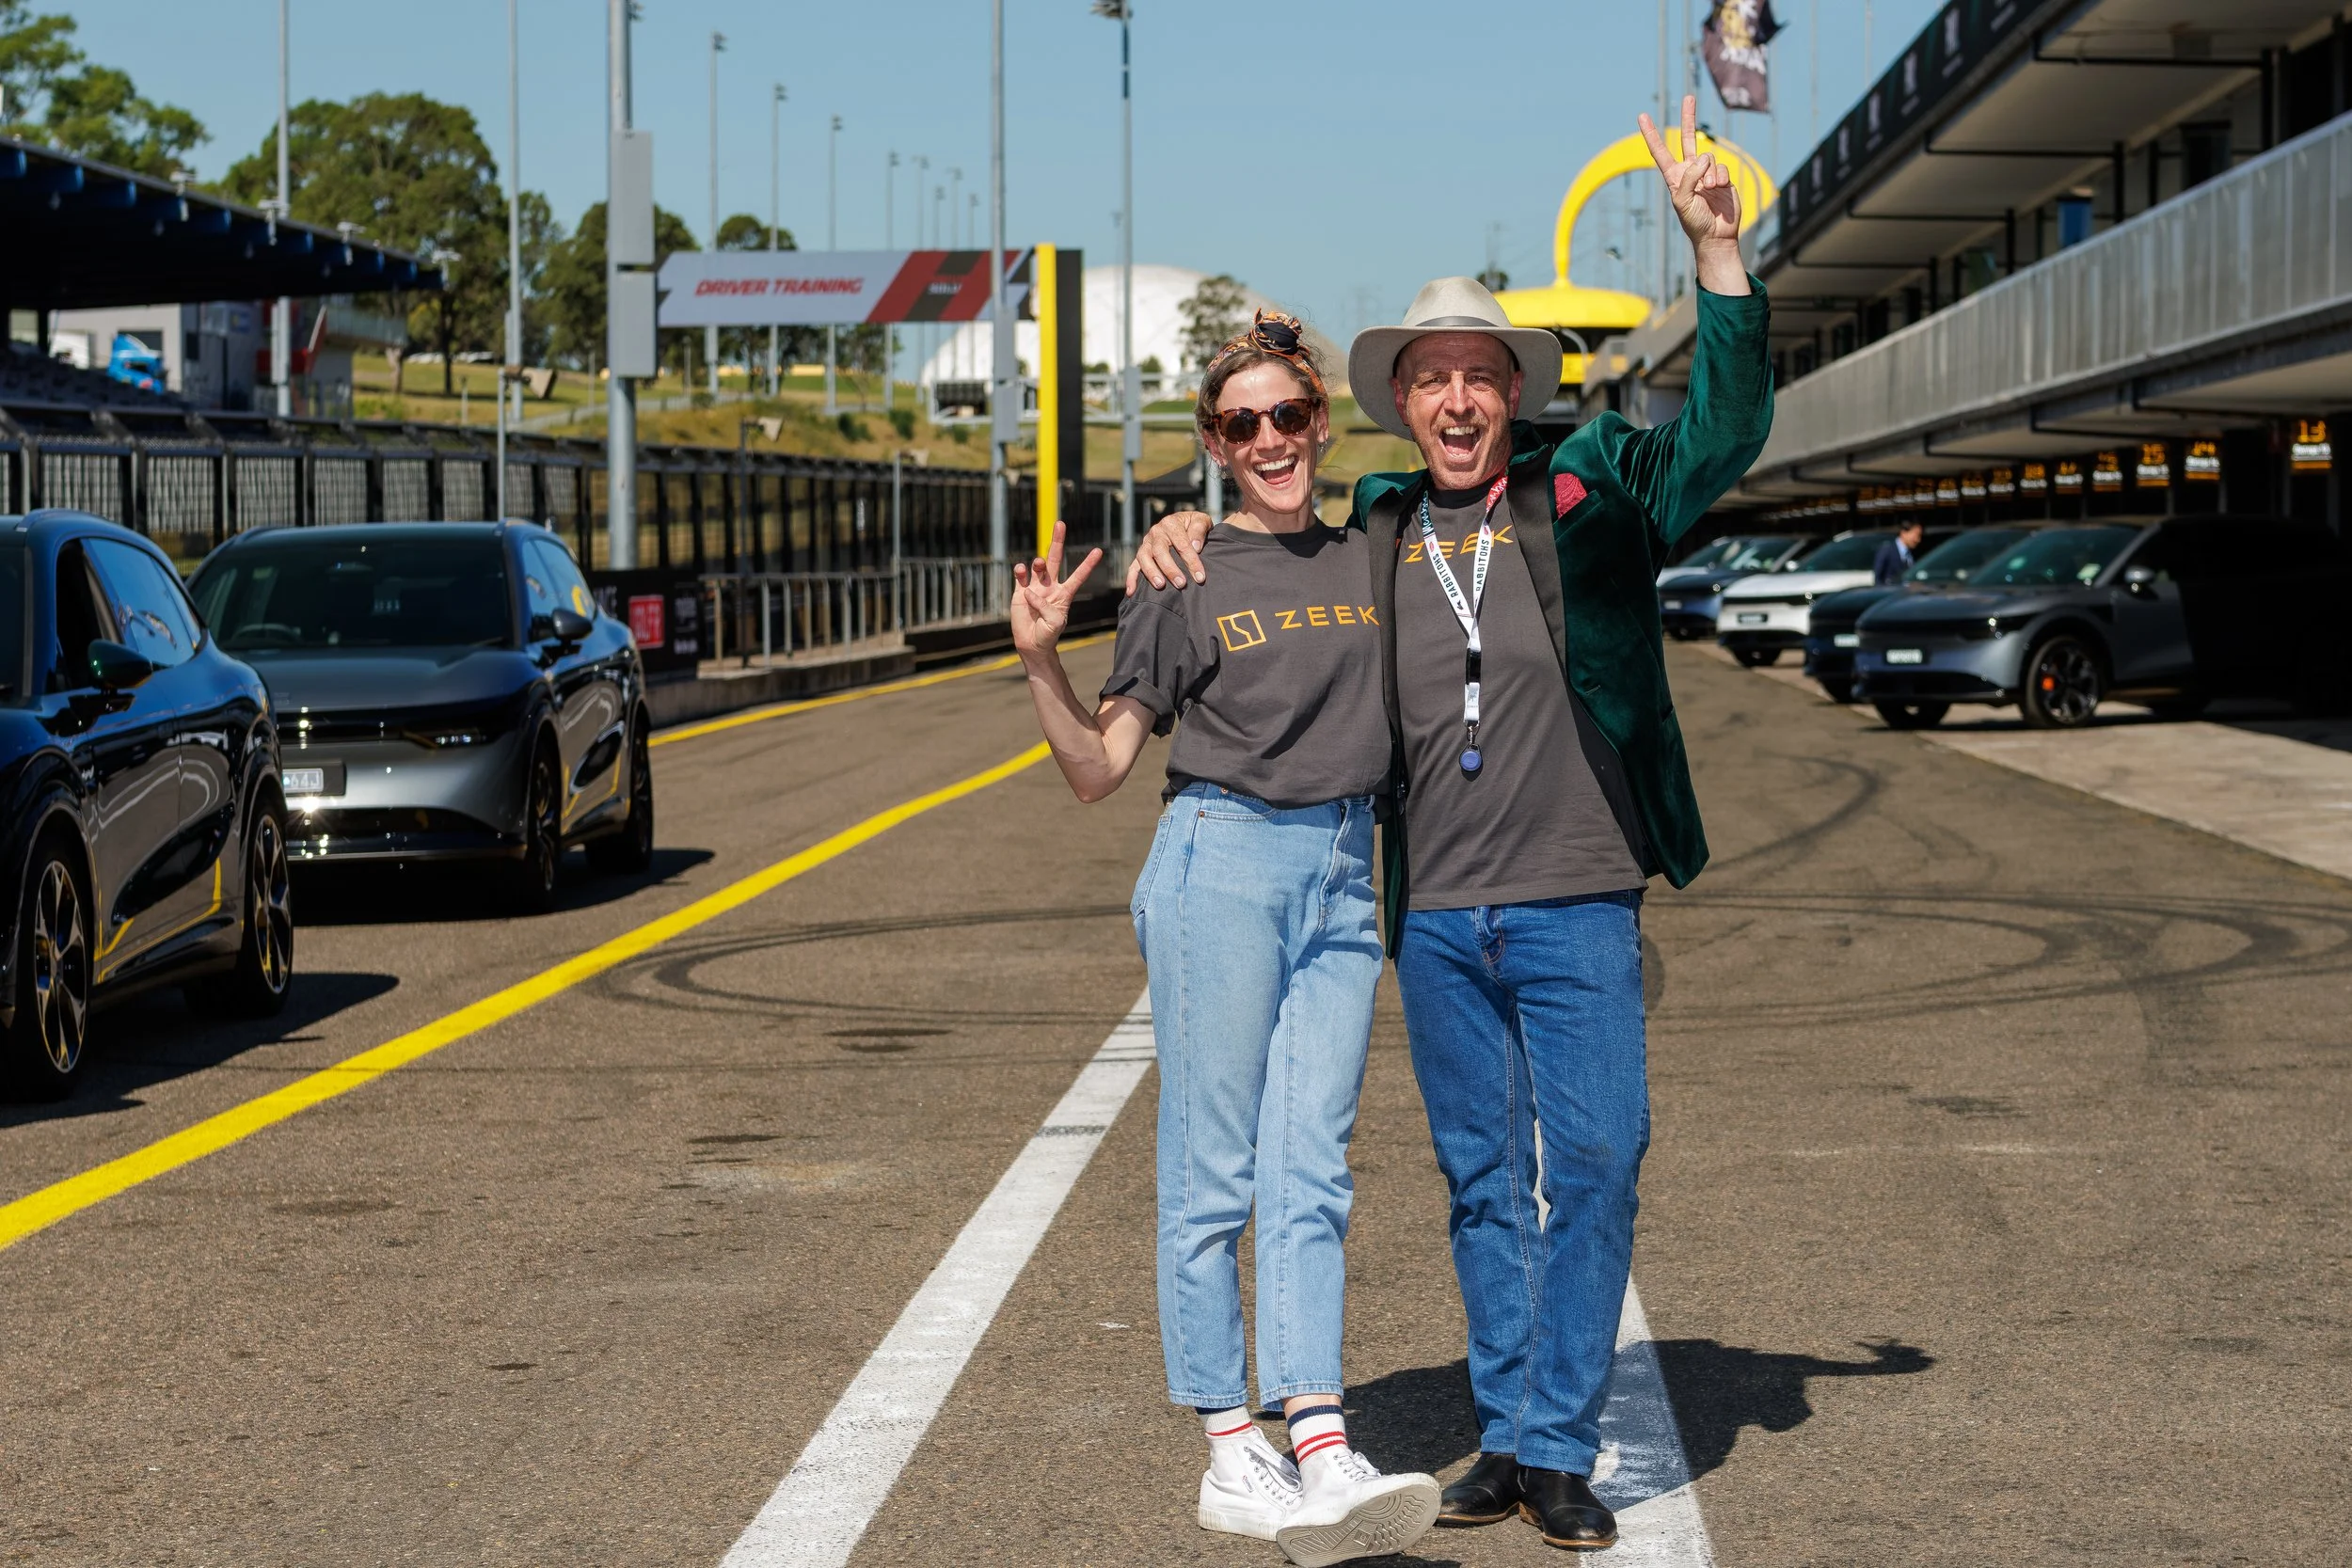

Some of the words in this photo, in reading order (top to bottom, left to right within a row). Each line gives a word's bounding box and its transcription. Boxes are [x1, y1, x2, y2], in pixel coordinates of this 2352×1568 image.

[694, 277, 770, 296] DRIVER
[772, 277, 865, 294] TRAINING
[1433, 553, 1458, 598] RABBITOHS
